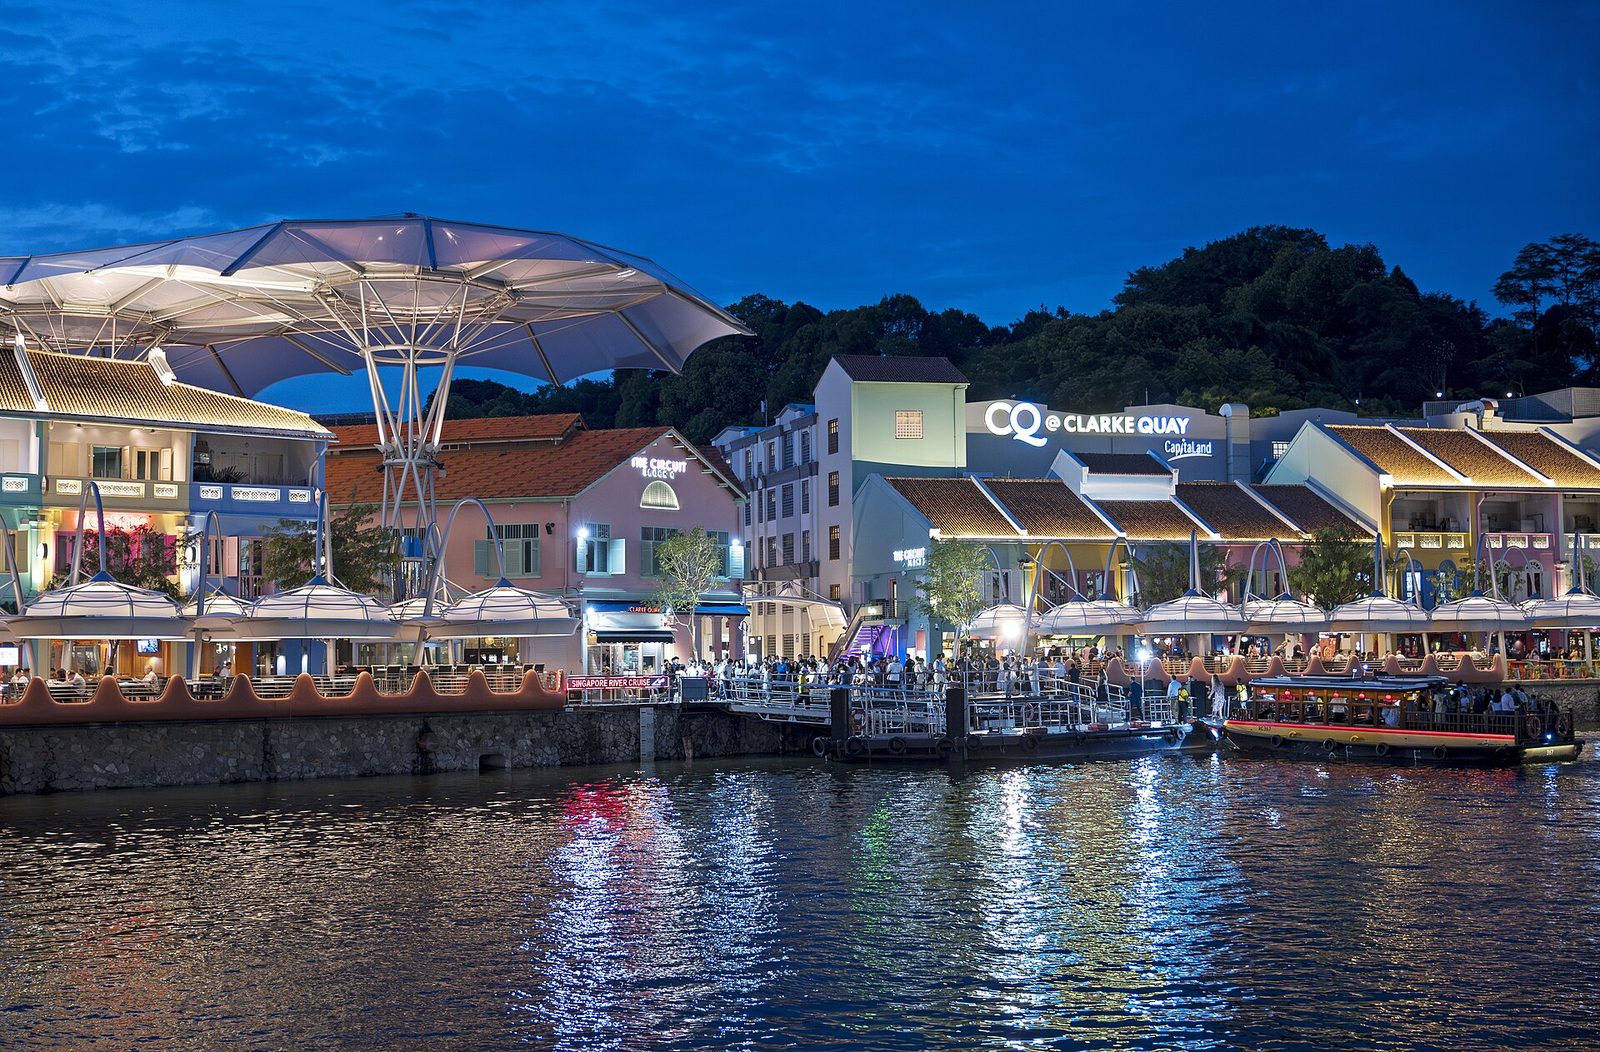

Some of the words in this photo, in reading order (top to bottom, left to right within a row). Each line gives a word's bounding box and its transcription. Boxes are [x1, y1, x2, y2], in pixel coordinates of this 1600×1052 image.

[984, 401, 1048, 447] CQ
[1045, 415, 1061, 432] @
[1063, 416, 1135, 433] CLARKE
[1137, 417, 1189, 434] QUAY
[1164, 438, 1212, 457] CapitaLand
[631, 457, 648, 468] THE
[649, 458, 688, 473] CIRCUIT
[571, 679, 607, 688] SINGAPORE
[608, 679, 627, 687] RIVER
[628, 678, 651, 686] CRUISE
